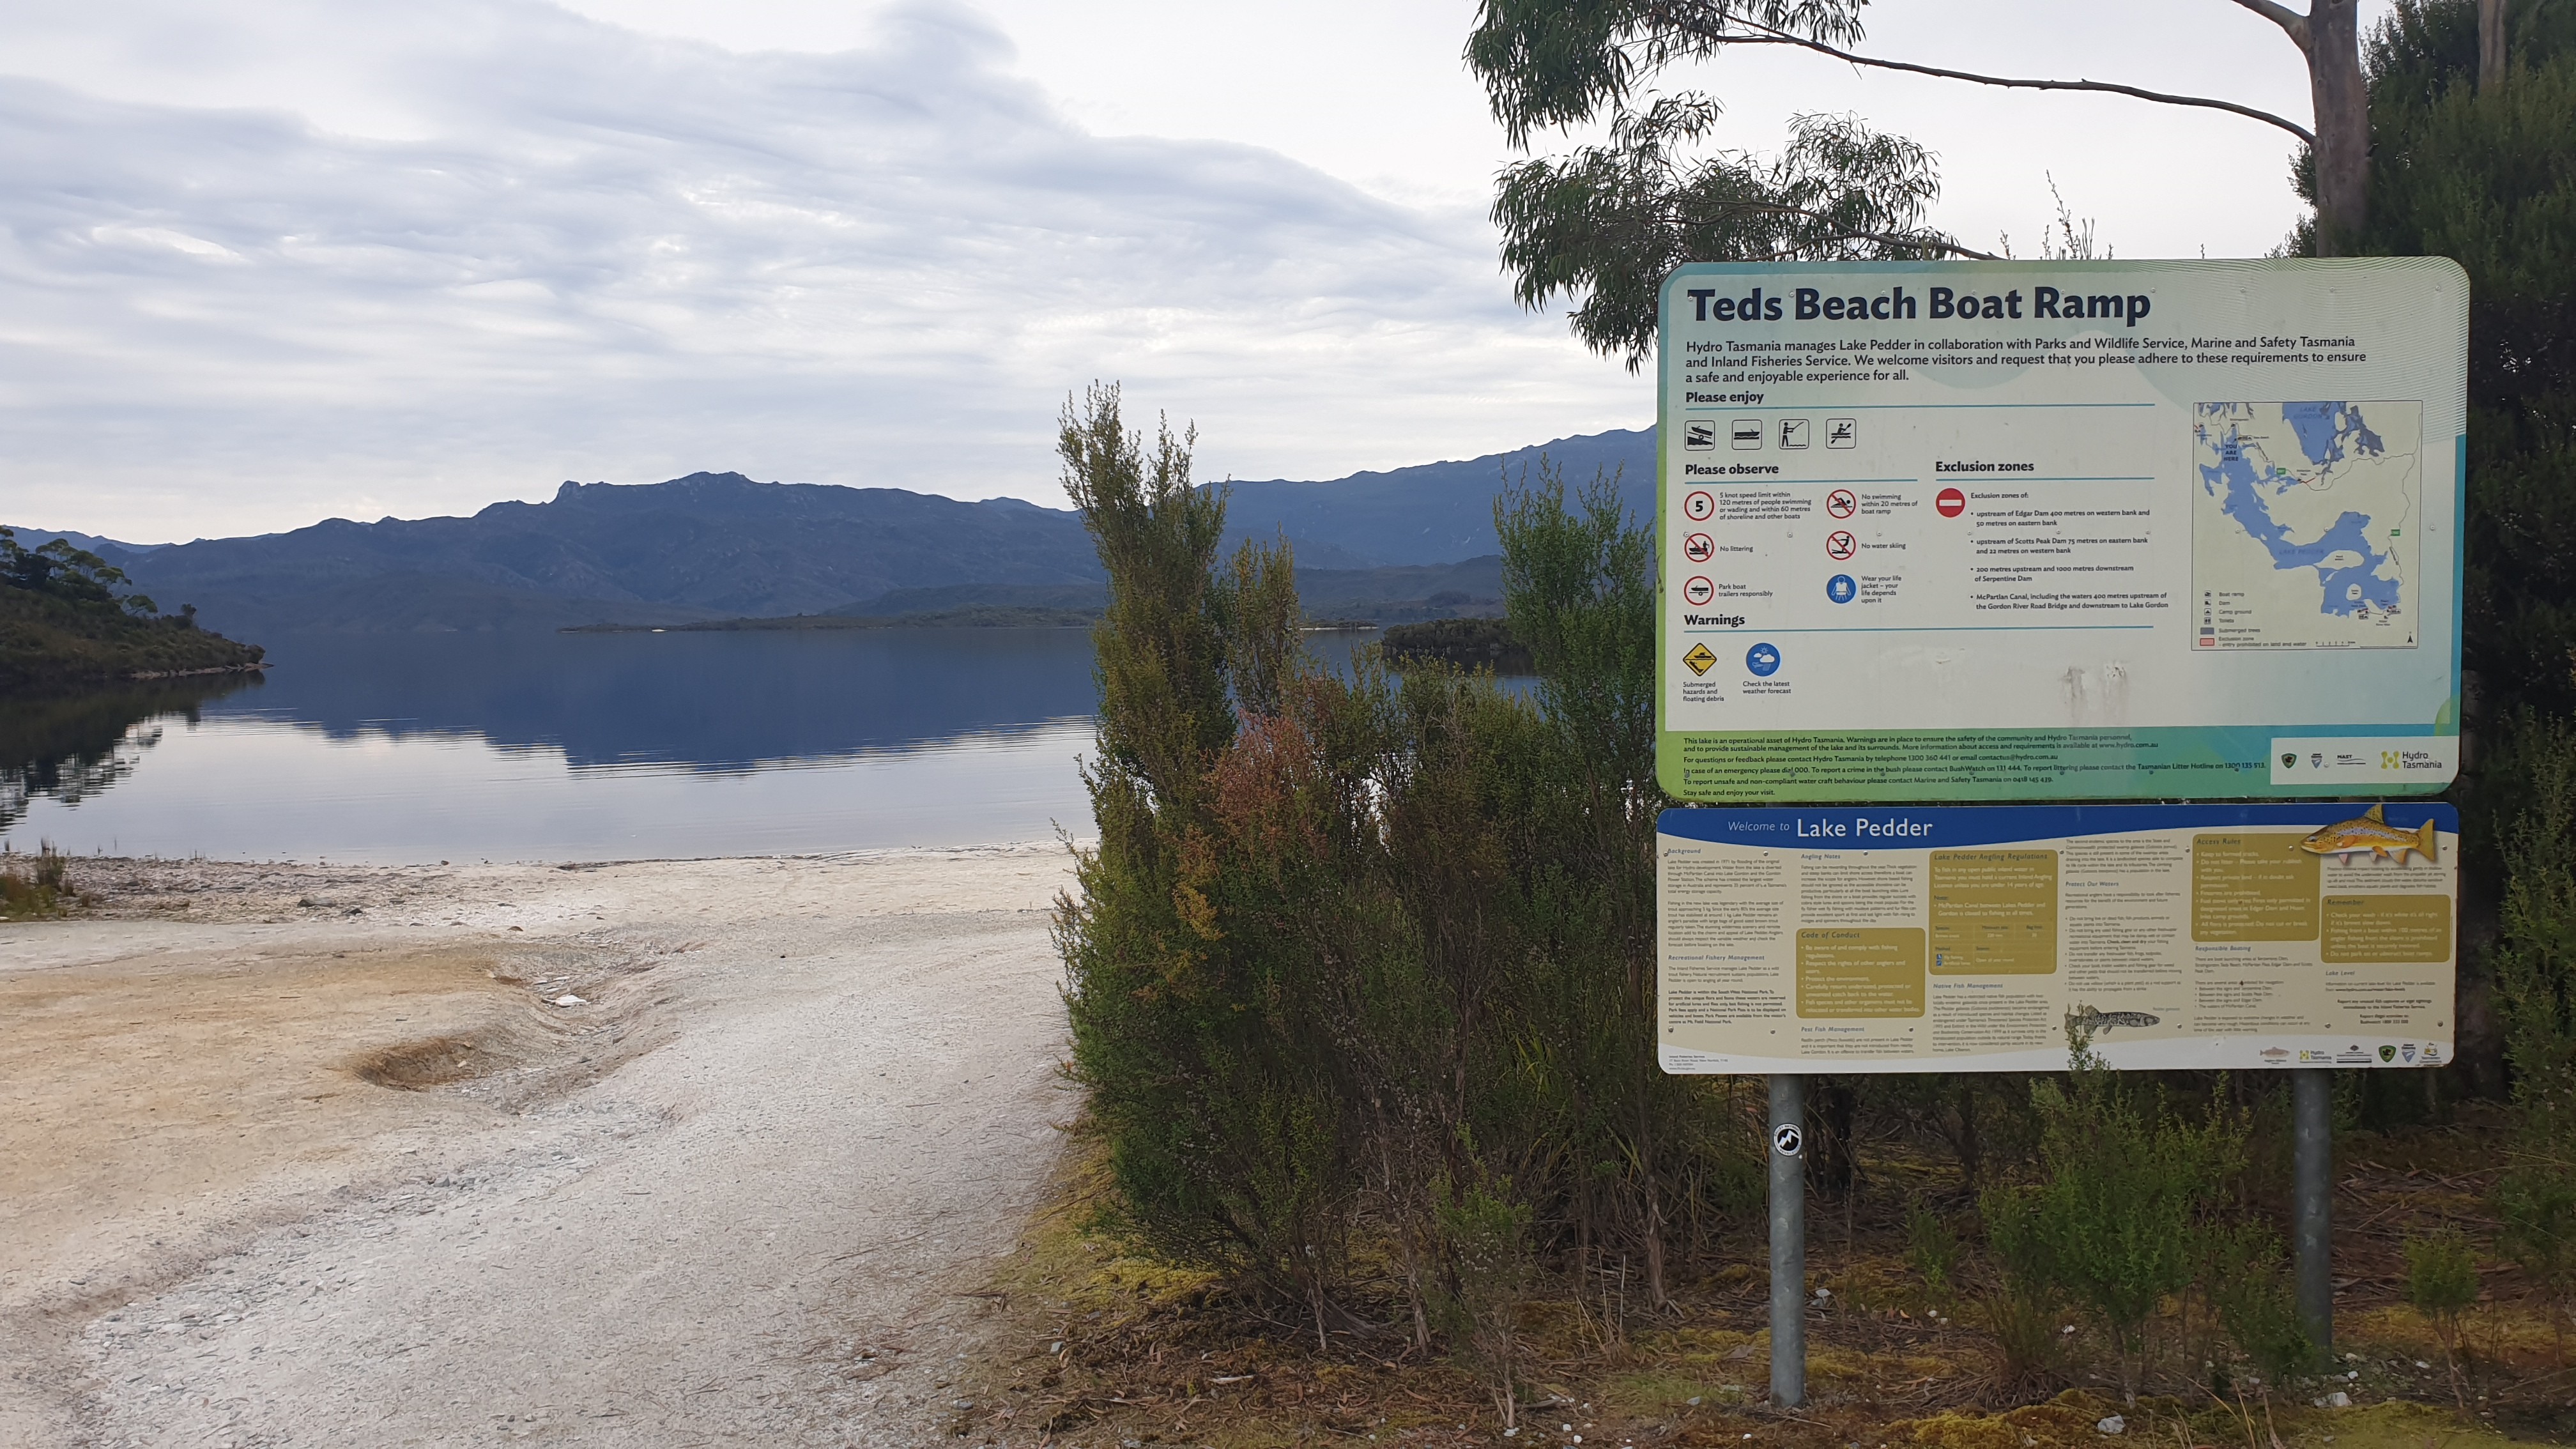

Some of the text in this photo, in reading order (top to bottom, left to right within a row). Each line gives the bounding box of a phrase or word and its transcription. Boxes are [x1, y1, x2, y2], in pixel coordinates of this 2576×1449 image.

[1687, 286, 2151, 327] Teds Beach Boat Ramp
[1687, 336, 2355, 355] Hydro Tasmania manages Lake Pedder in collaboration with Parks and Wildlife Service, Marine and Safety Tasmania
[1686, 356, 1708, 367] and
[1712, 356, 1748, 367] Inland
[1752, 355, 1802, 366] Fisheries
[1805, 355, 1851, 366] Service.
[1854, 355, 1874, 365] We
[1877, 355, 1929, 365] welcome
[1932, 354, 1973, 365] visitors
[1977, 353, 1998, 364] and
[2002, 355, 2045, 367] request
[2048, 353, 2071, 364] that
[2074, 356, 2095, 367] you
[2099, 353, 2135, 366] please
[2138, 353, 2178, 364] adhere
[2181, 354, 2193, 363] to
[2196, 352, 2228, 363] these
[2232, 351, 2309, 365] requirements
[2312, 353, 2324, 362] to
[1696, 371, 1720, 383] safe
[1722, 371, 1744, 382] and
[1748, 370, 1803, 385] enjoyable
[1807, 370, 1870, 383] experience
[1873, 369, 1890, 380] for
[1893, 369, 1909, 380] all.
[1686, 391, 1765, 404] Please enjoy
[1685, 463, 1779, 475] Please observe
[1936, 460, 2034, 471] Exclusion zones
[1696, 501, 1703, 512] 5
[1782, 498, 1812, 507] swimming
[1861, 583, 1878, 591] jacket
[1684, 614, 1745, 627] Warnings
[2403, 751, 2428, 761] Hydro
[1728, 821, 1775, 831] Welcome
[1798, 818, 1933, 836] Lake Pedder
